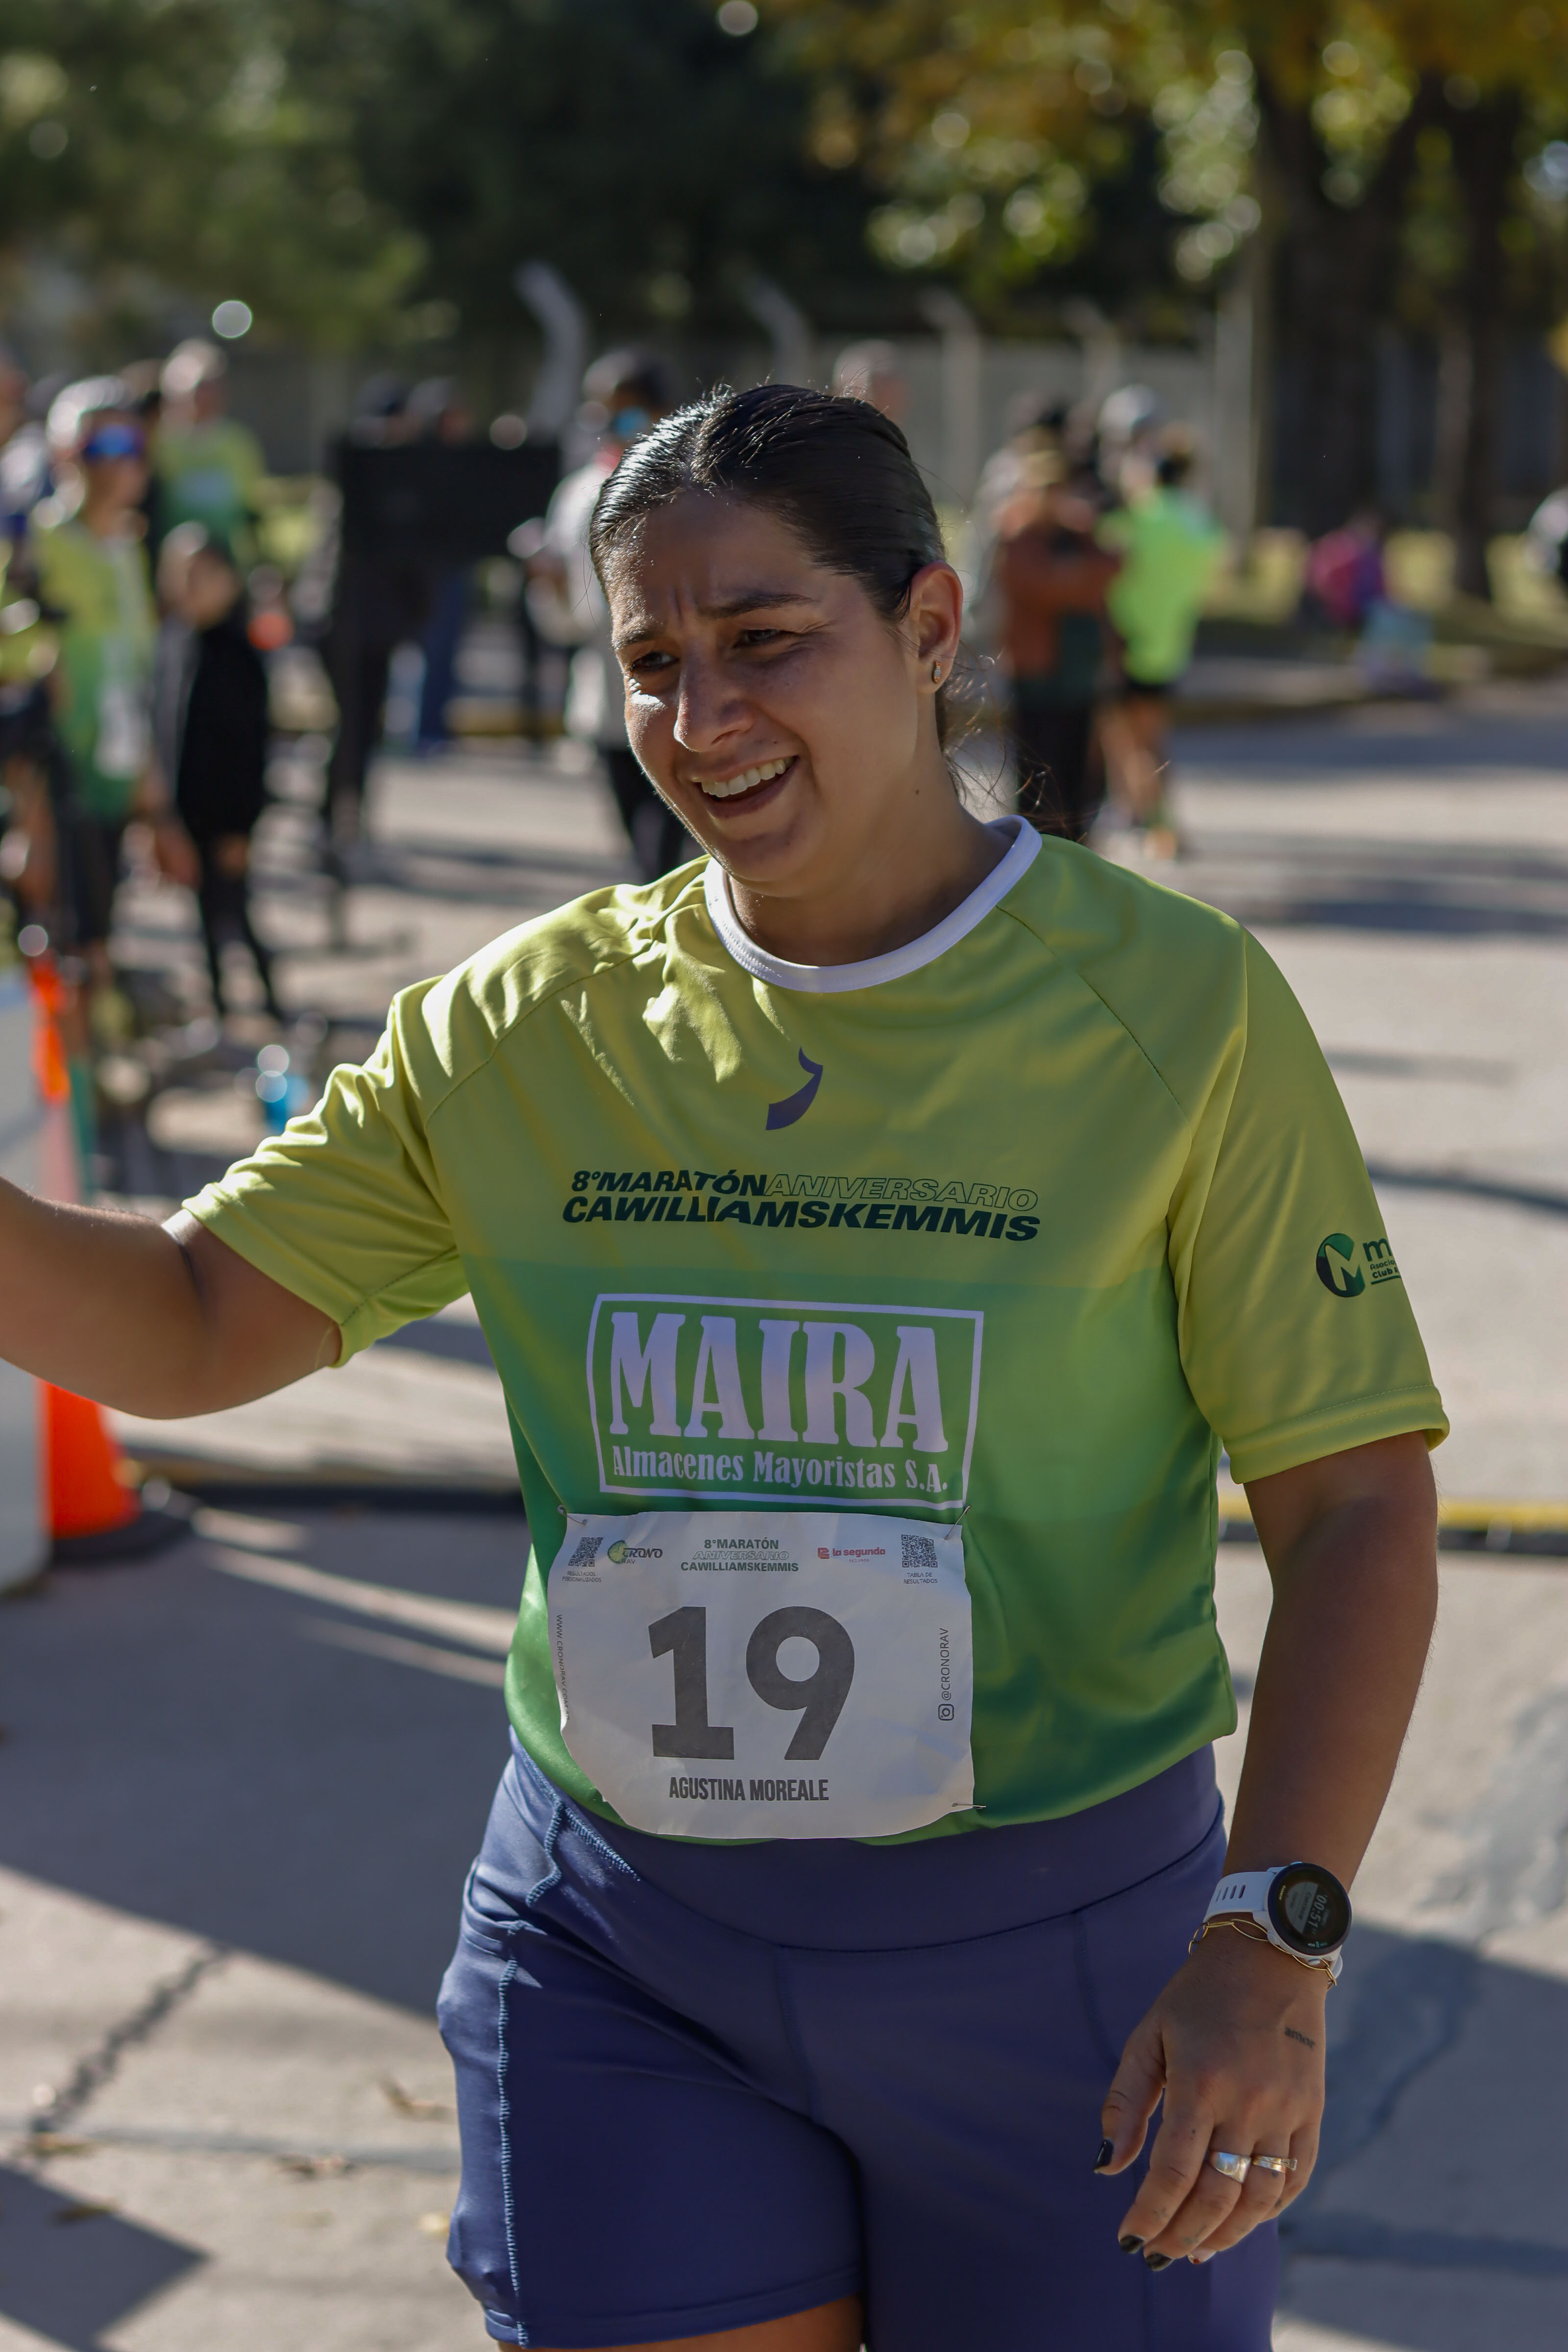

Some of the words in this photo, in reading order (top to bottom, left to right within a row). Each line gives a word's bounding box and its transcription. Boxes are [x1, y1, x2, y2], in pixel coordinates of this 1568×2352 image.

[563, 1196, 1041, 1241] CAWILLIAMSKEMMIS
[1372, 1268, 1393, 1278] Club
[610, 1312, 948, 1452] MAIRA
[612, 1445, 743, 1481] Almacenes
[753, 1451, 895, 1488] Mayoristas
[906, 1459, 947, 1493] S.A.
[622, 1547, 663, 1558] CRONO
[692, 1550, 789, 1560] ANIVERSARIO
[833, 1548, 842, 1556] la
[843, 1547, 886, 1558] segunda
[681, 1562, 799, 1572] CAWILLIAMSKEMMIS
[939, 1628, 952, 1701] @CRONORAV
[648, 1606, 855, 1760] 19
[669, 1777, 746, 1800] AGUSTINA
[749, 1779, 830, 1801] MOREALE
